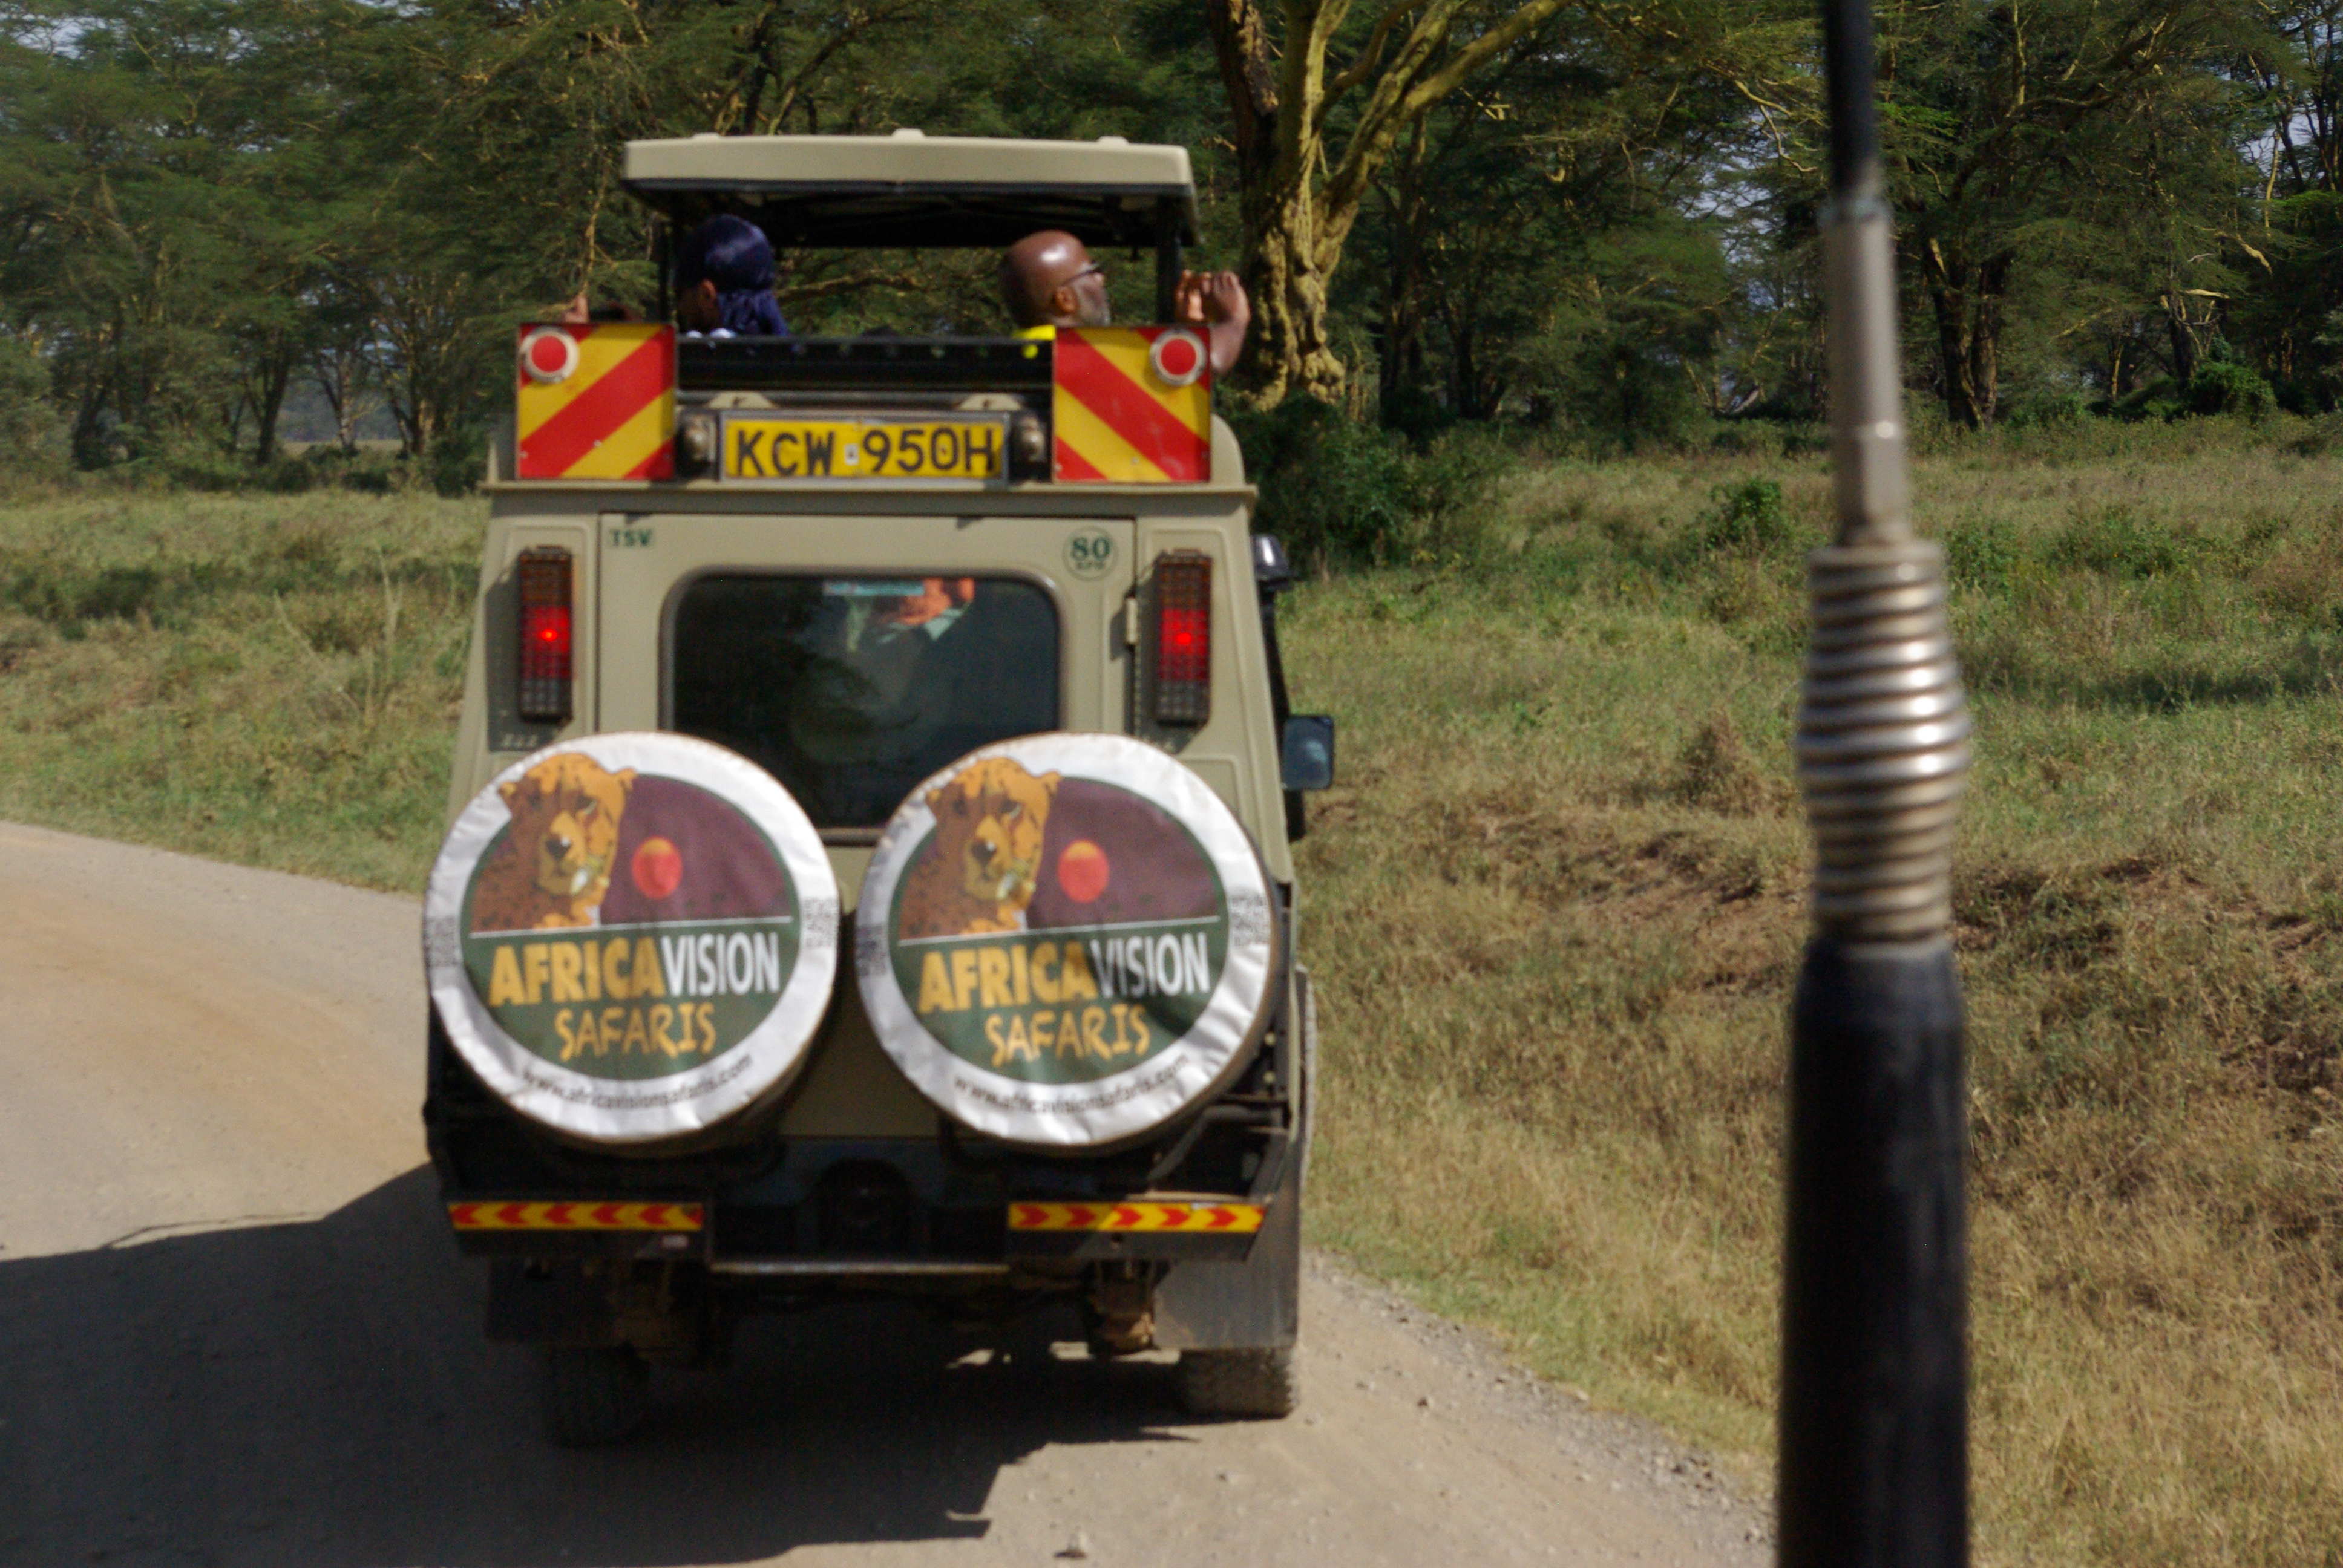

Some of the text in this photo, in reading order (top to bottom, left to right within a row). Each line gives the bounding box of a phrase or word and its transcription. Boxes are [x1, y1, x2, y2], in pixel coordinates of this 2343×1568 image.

[736, 426, 995, 477] KCW 950H
[1070, 536, 1111, 562] 80
[554, 1001, 718, 1062] SAFARIS
[983, 1002, 1152, 1068] SAFARIS
